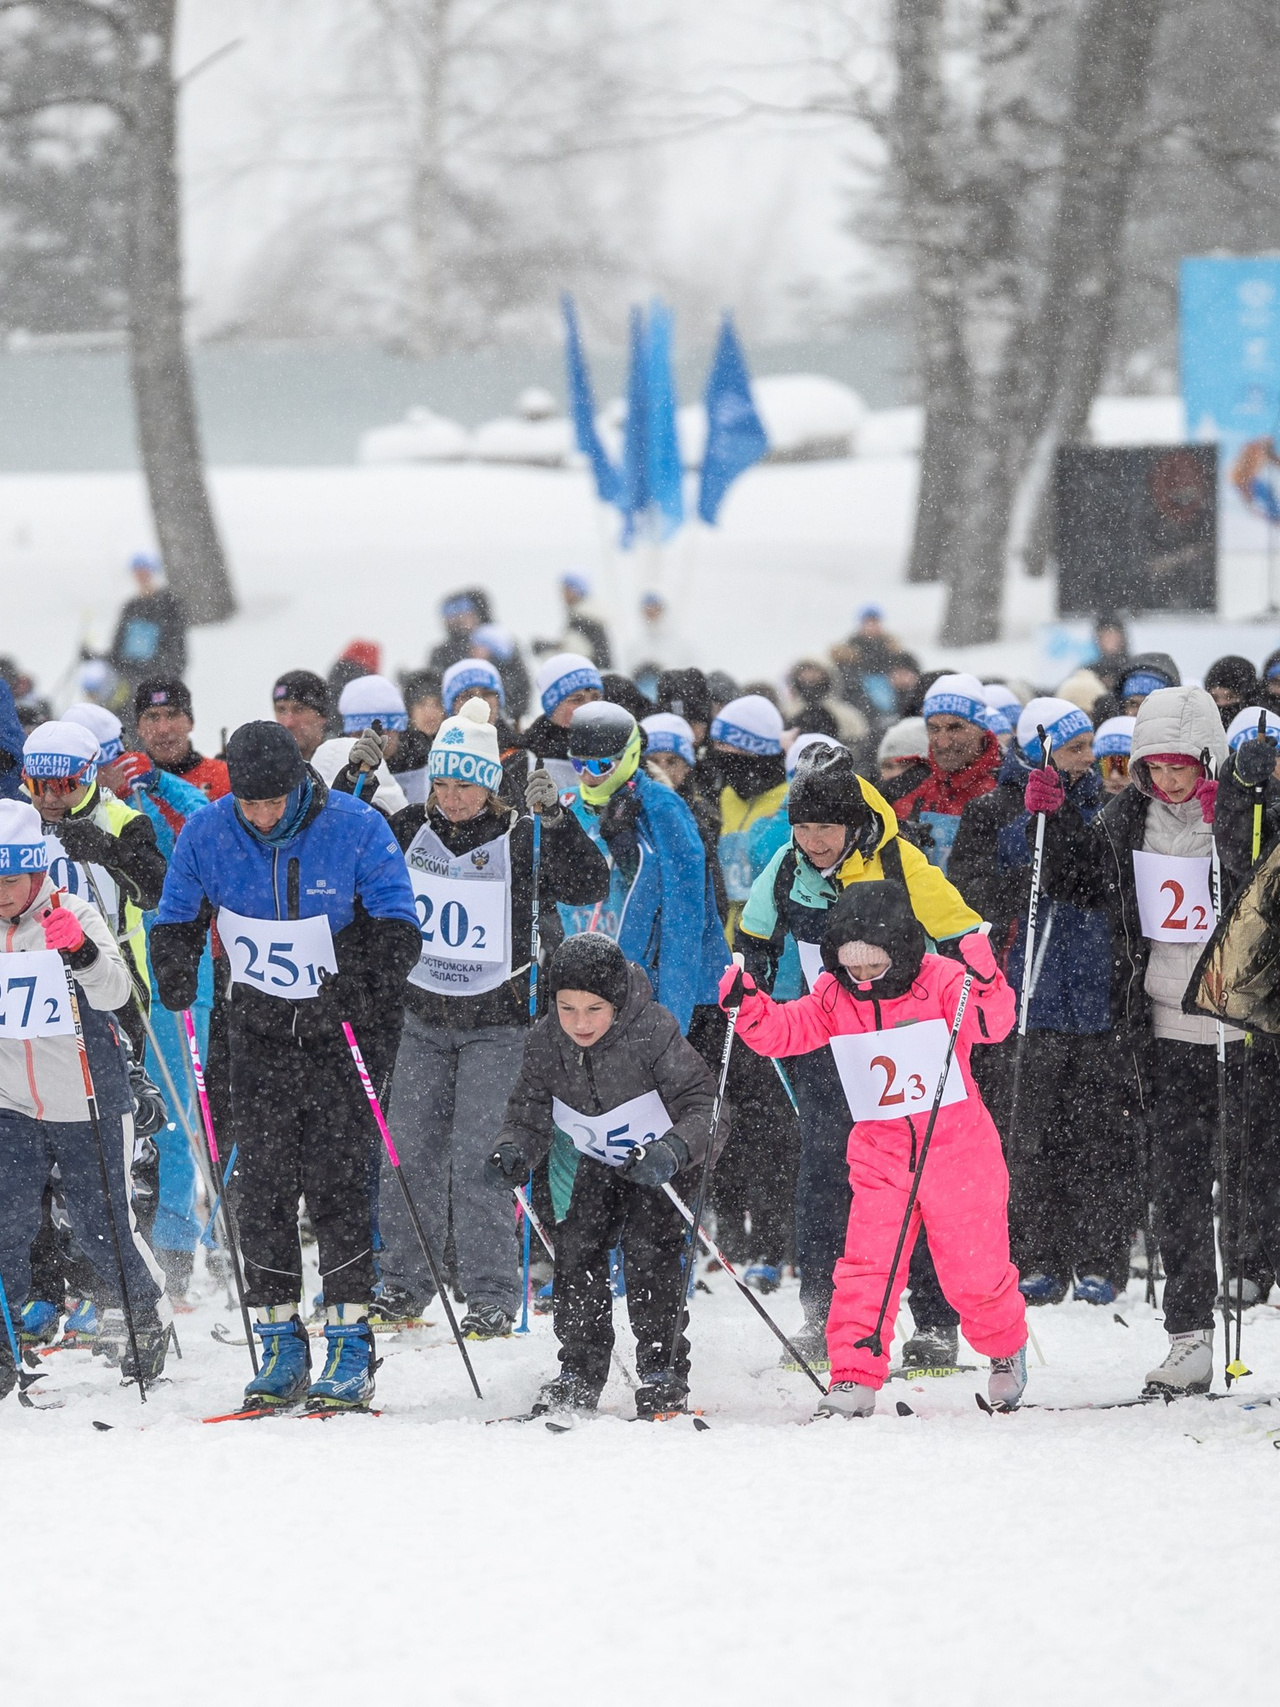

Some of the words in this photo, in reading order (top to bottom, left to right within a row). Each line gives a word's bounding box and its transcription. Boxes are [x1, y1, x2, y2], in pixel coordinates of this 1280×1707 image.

[410, 853, 450, 877] РОССИИ
[531, 900, 541, 957] SPINE
[420, 956, 483, 972] ОСТРОМСКАЯ
[954, 990, 969, 1029] NORDWAY
[332, 1367, 369, 1395] SPINE
